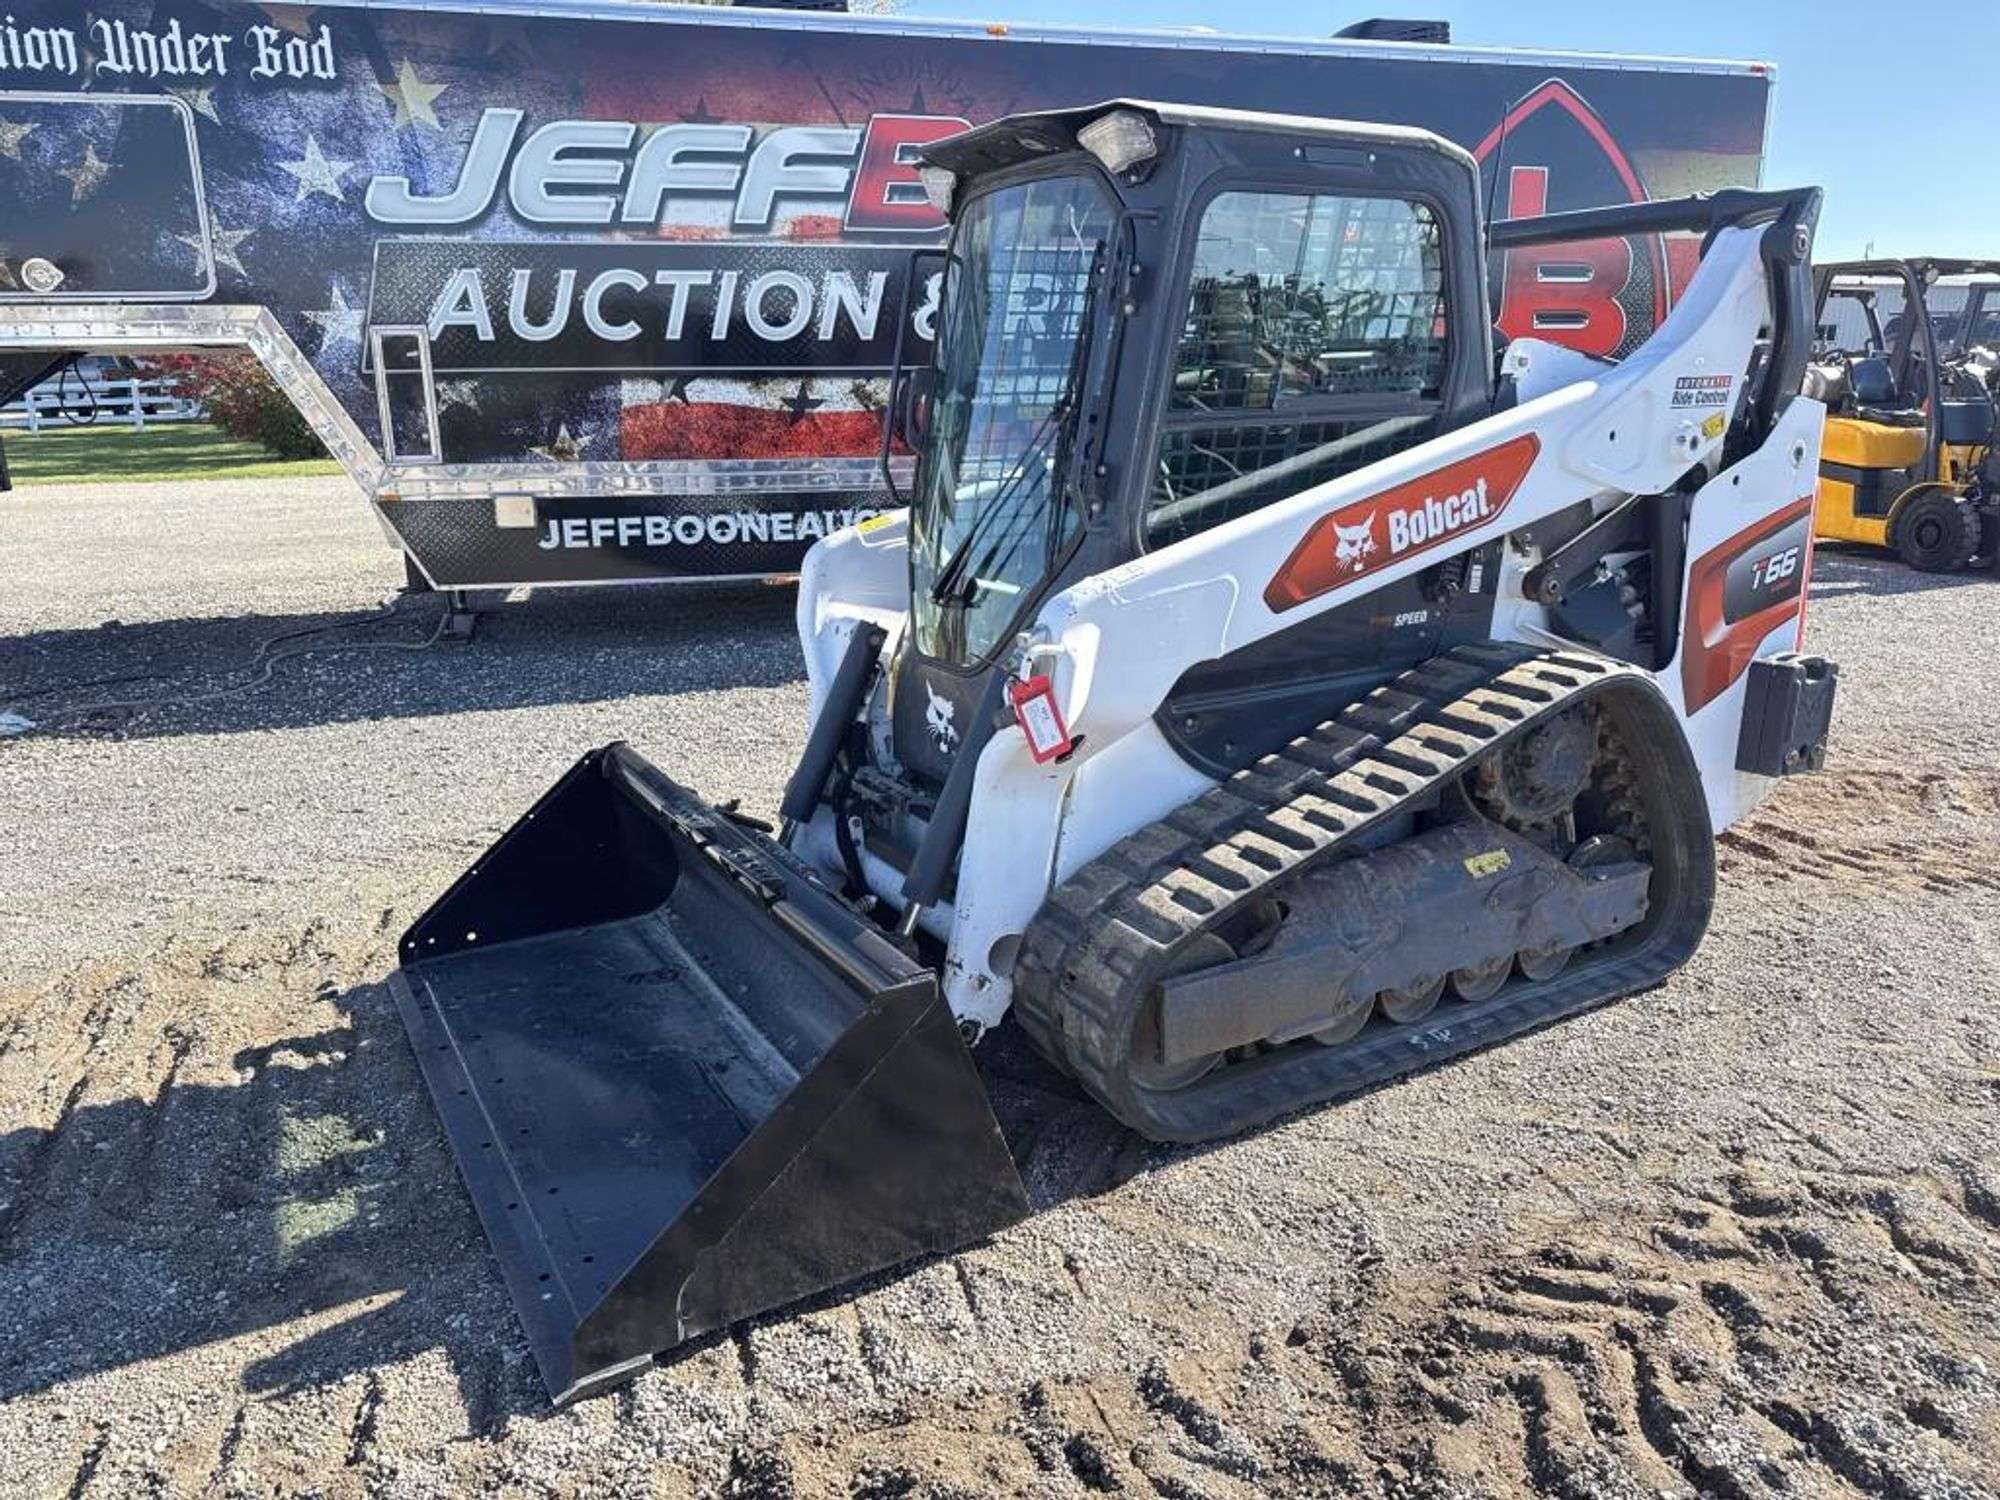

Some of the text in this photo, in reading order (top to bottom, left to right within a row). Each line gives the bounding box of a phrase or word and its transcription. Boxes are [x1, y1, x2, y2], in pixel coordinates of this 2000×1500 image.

[90, 17, 232, 78] Under
[244, 24, 337, 81] God
[428, 267, 887, 342] AUCTION
[1672, 388, 1730, 405] Ride Control
[1387, 476, 1490, 555] Bobcat
[1752, 546, 1800, 591] T66
[1393, 609, 1428, 627] SPEED
